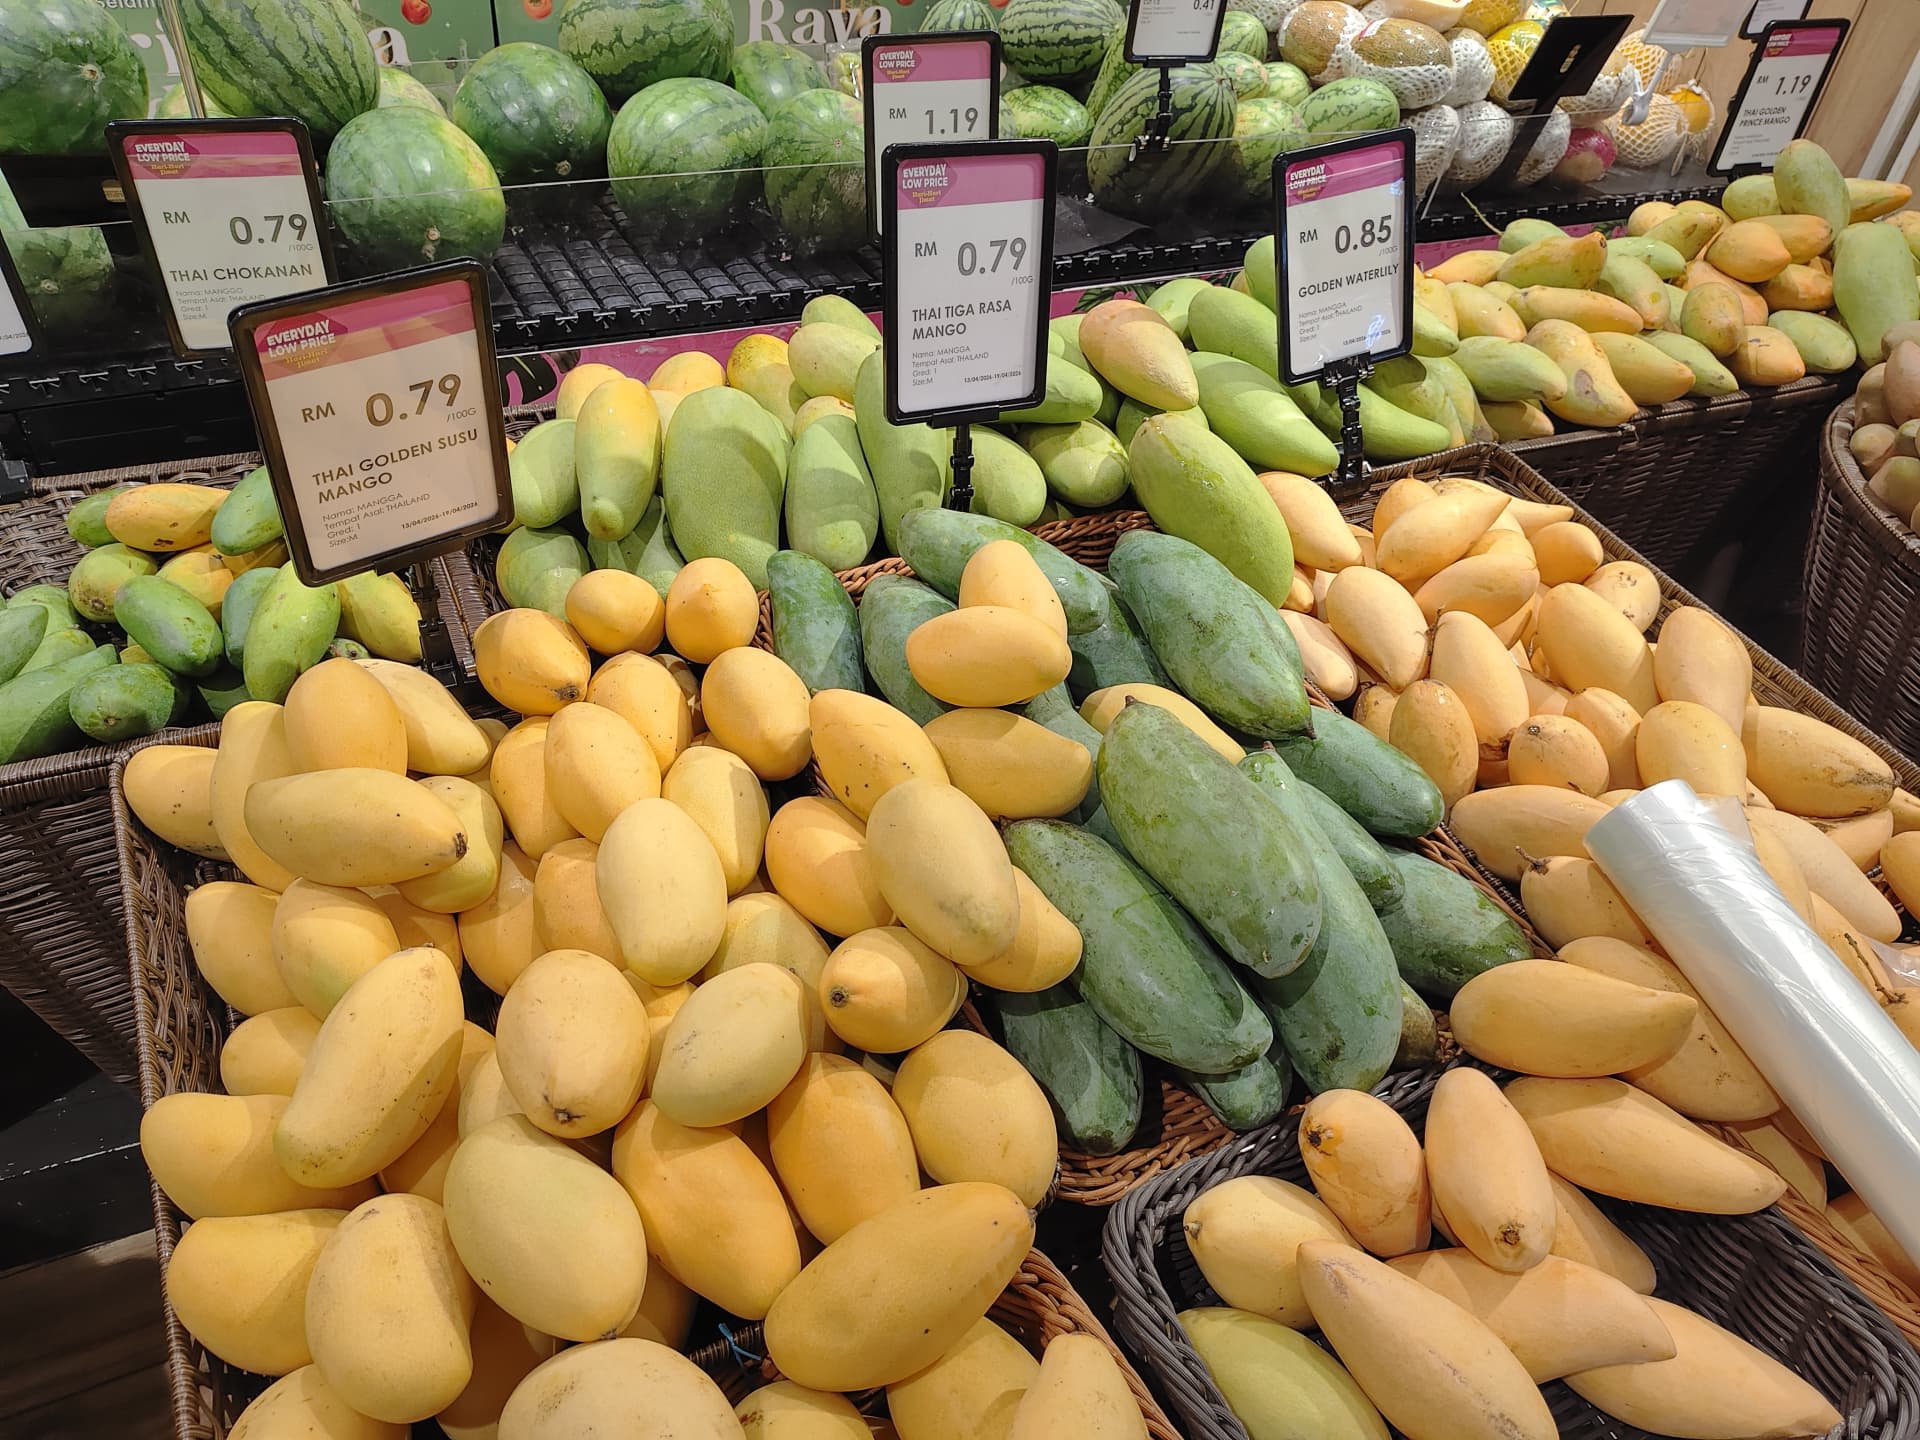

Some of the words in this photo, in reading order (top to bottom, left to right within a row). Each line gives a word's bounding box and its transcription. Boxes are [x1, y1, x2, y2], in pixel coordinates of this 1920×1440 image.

[879, 60, 895, 68] LOW
[896, 60, 916, 68] PRICE
[880, 50, 914, 60] EVERYDAY
[1776, 74, 1811, 95] 1.19
[889, 108, 907, 119] RM
[925, 108, 978, 134] 1.19
[135, 141, 185, 153] EVERYDAY
[136, 154, 159, 162] LOW
[162, 152, 190, 162] PRICE
[903, 164, 947, 178] EVERYDAY
[1290, 164, 1326, 181] EVERYDAY
[902, 179, 923, 189] LOW
[924, 177, 948, 188] PRICE
[1289, 180, 1306, 190] LOW
[163, 211, 190, 225] RM
[230, 214, 308, 245] 0.79
[1300, 228, 1318, 244] RM
[1335, 214, 1392, 254] 0.85
[914, 241, 938, 258] RM
[958, 237, 1027, 276] 0.79
[1379, 246, 1398, 256] /100G
[170, 270, 208, 283] THAI
[214, 264, 313, 280] CHOKANAN
[1011, 276, 1033, 285] /100G
[1298, 278, 1343, 298] GOLDEN
[1346, 264, 1399, 286] WATERLILY
[912, 306, 941, 322] THAI
[945, 304, 975, 319] TIGA
[979, 300, 1012, 314] RASA
[266, 319, 330, 347] EVERYDAY
[912, 322, 967, 340] MANGO
[268, 342, 298, 359] LOW
[300, 332, 337, 350] PRICE
[937, 346, 971, 356] MANGGA
[957, 352, 989, 363] THAILAND
[302, 401, 336, 424] RM
[365, 374, 462, 427] 0.79
[446, 407, 477, 423] /100G
[312, 463, 353, 486] THAI
[359, 441, 433, 472] GOLDEN
[438, 428, 478, 450] SUSU
[319, 472, 393, 504] MANGO
[322, 507, 355, 522] Nama:
[357, 493, 404, 512] MANGGA
[324, 515, 360, 531] Tempat
[363, 508, 385, 520] Asal:
[386, 493, 431, 512] THAILAND
[327, 526, 354, 539] Gred:
[329, 534, 358, 548] Size:M
